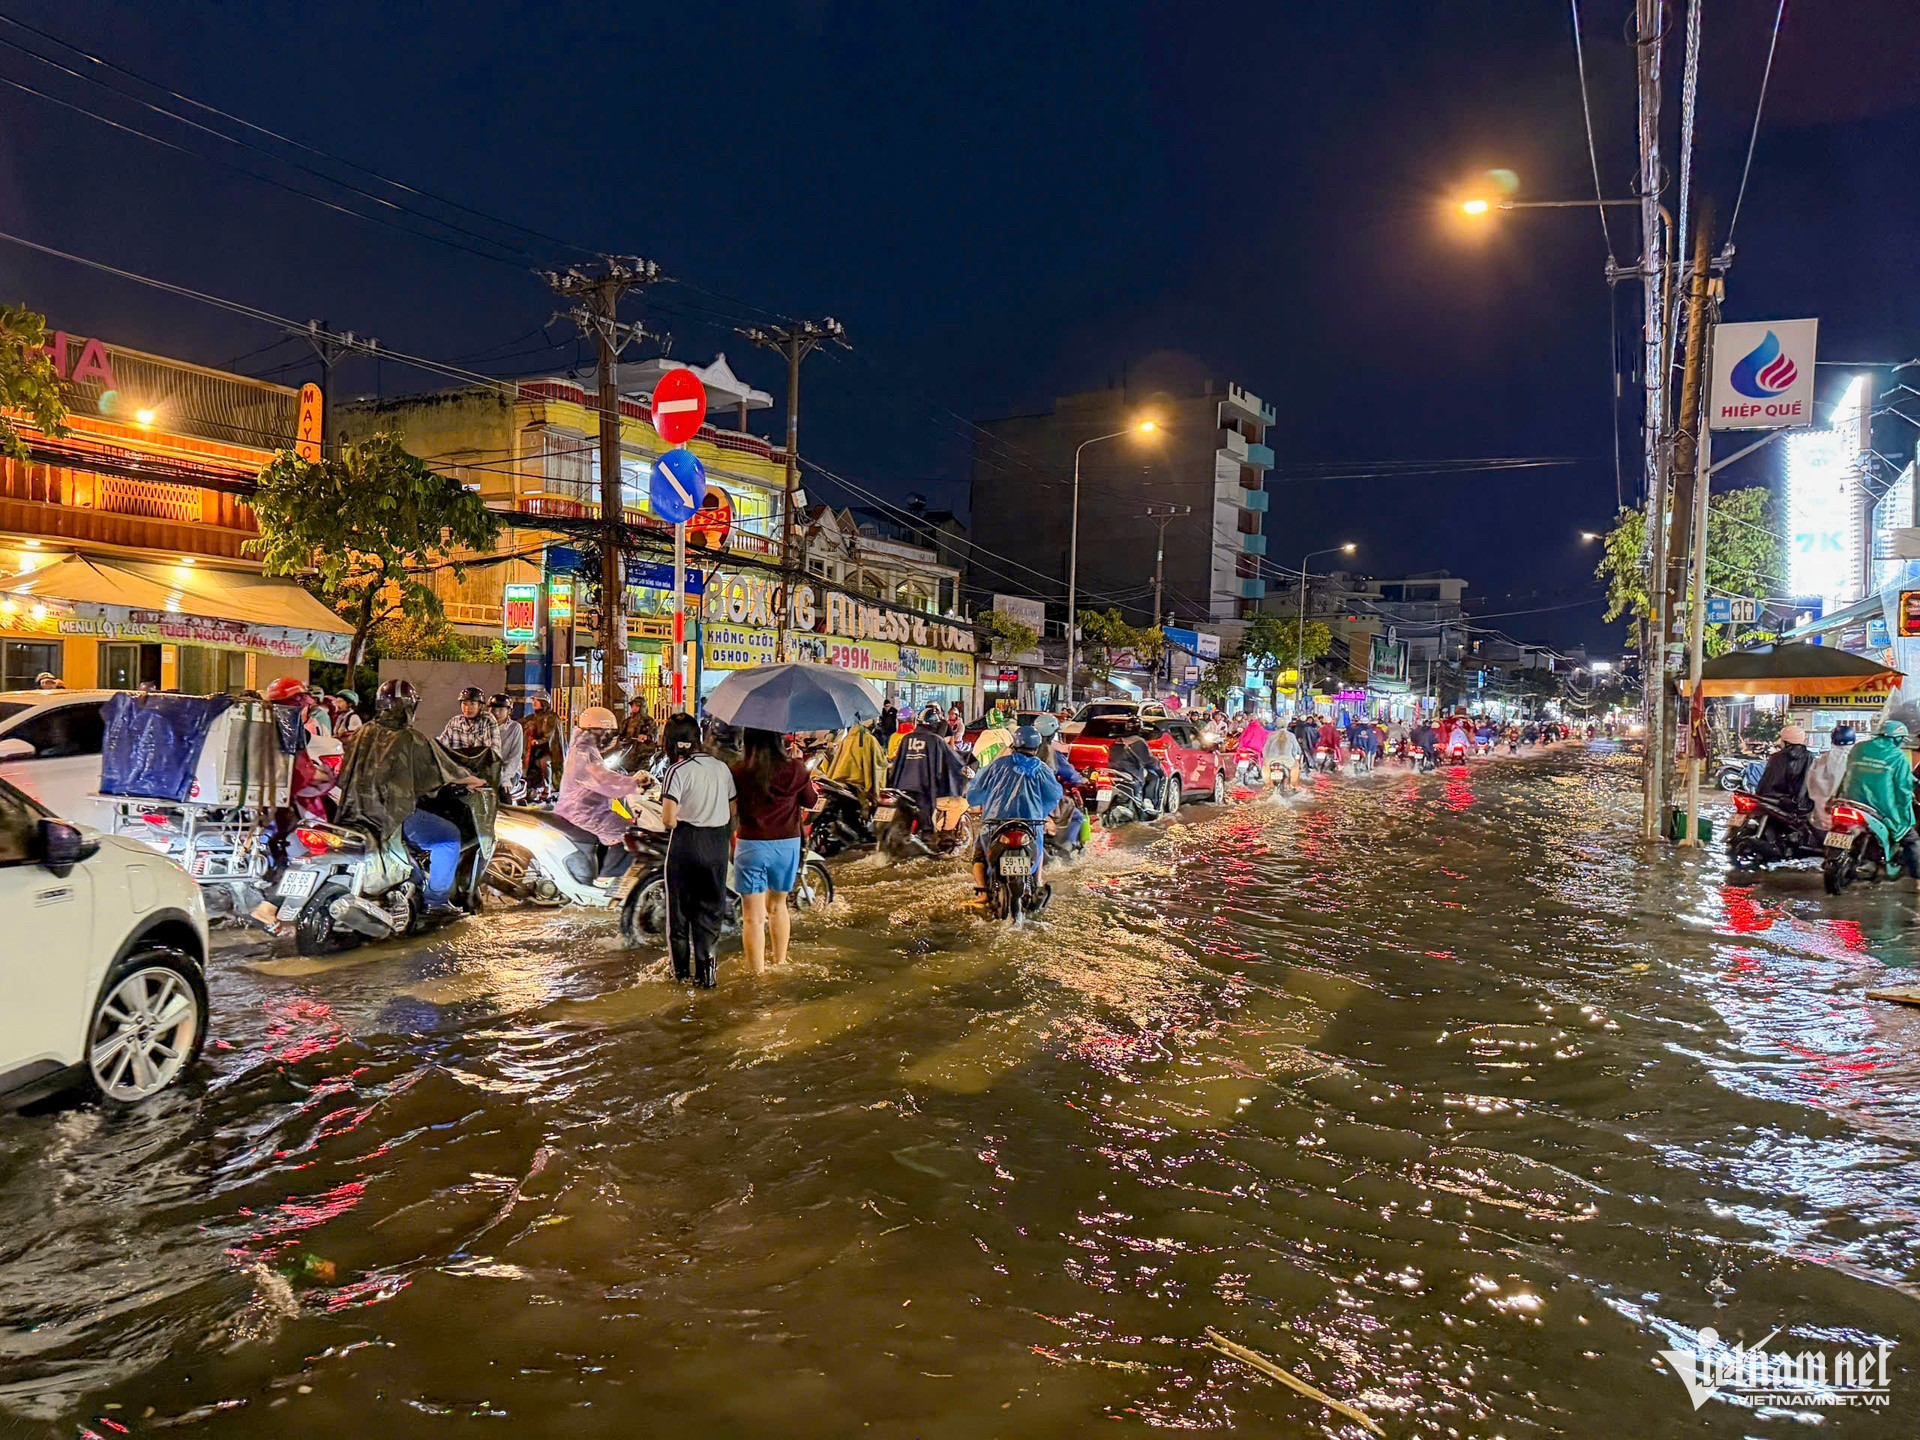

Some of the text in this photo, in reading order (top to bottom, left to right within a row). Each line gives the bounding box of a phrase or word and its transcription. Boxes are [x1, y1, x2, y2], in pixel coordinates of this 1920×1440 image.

[1721, 400, 1802, 419] HIỆP QUẾ
[507, 601, 534, 628] HOTEL
[59, 620, 95, 634] MENU
[708, 628, 744, 645] KHÔNG
[748, 632, 774, 648] GIỚI
[713, 649, 749, 662] 05H00
[832, 645, 870, 670] 299K
[919, 658, 937, 673] MUA
[938, 660, 943, 674] 3
[1794, 692, 1820, 704] BÚN
[1824, 695, 1850, 706] THỊT
